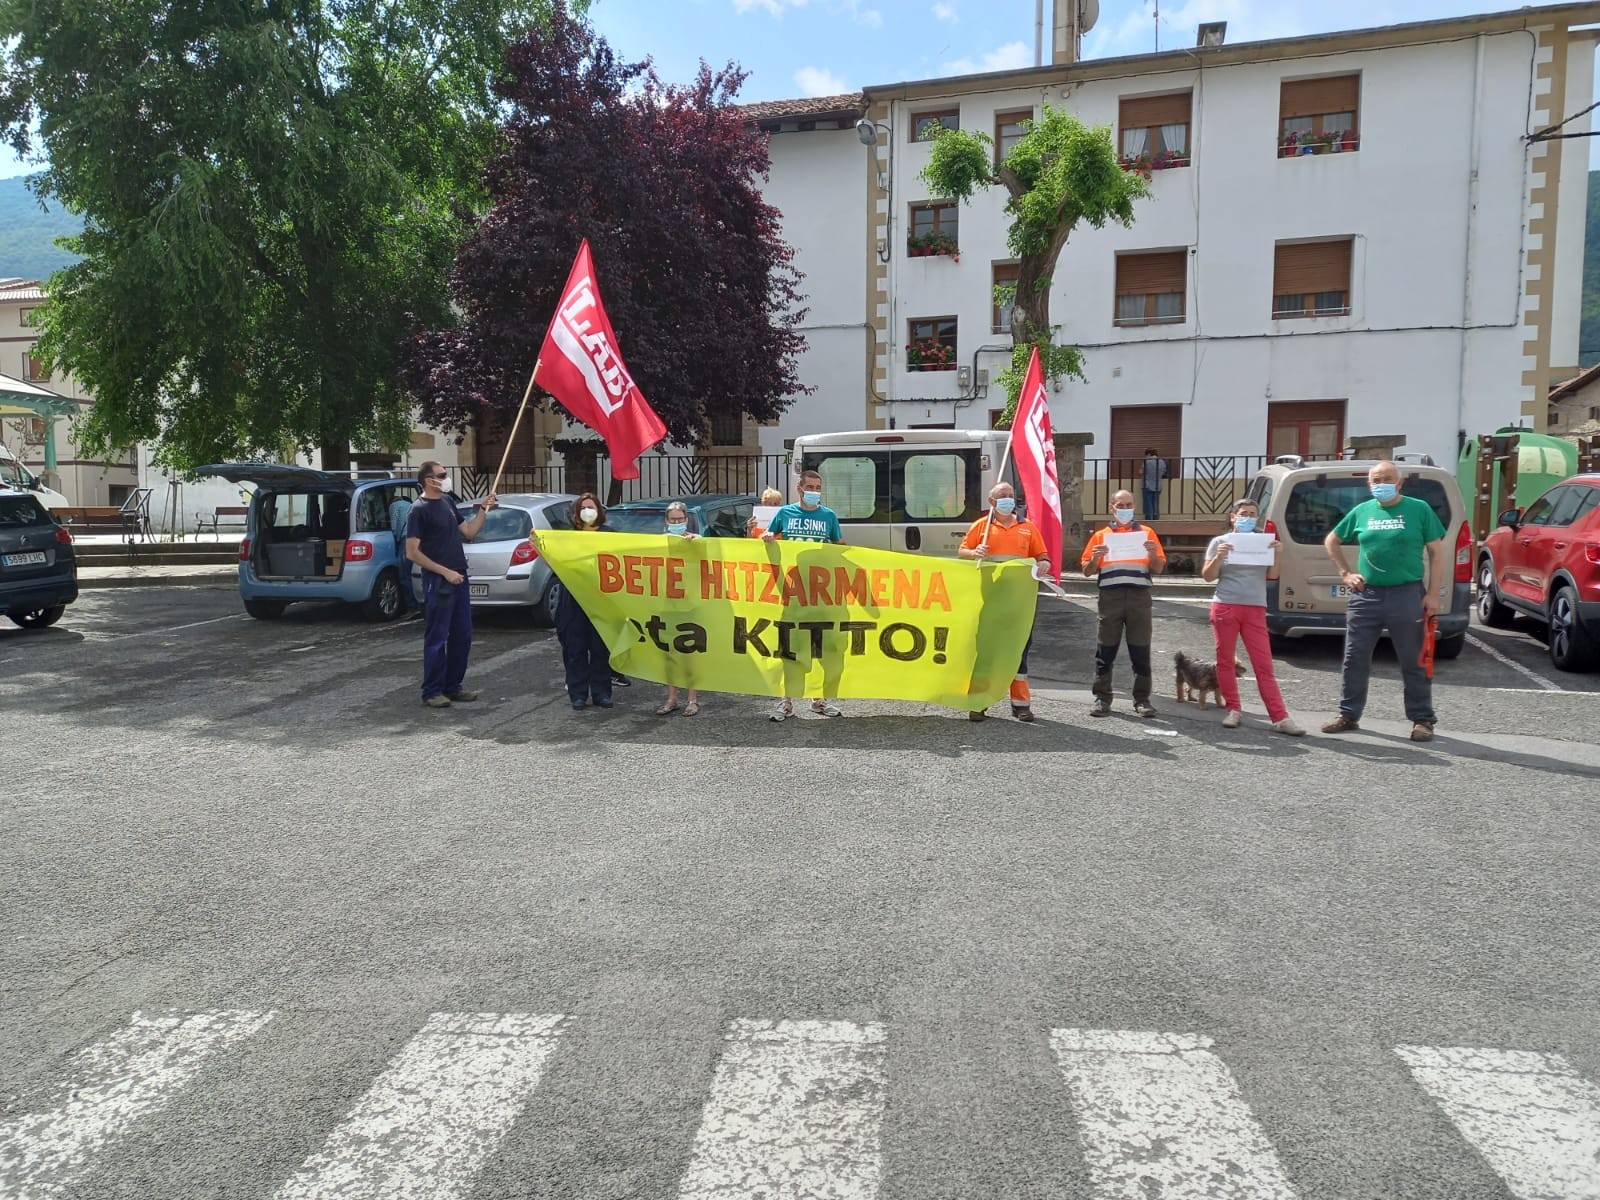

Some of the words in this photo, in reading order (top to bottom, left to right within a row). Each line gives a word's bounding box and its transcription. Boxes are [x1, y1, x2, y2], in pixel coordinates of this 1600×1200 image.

[787, 518, 826, 532] HELSINKI
[597, 554, 685, 599] BETE
[700, 559, 951, 611] HITZARMENA
[733, 616, 949, 664] KITTO!
